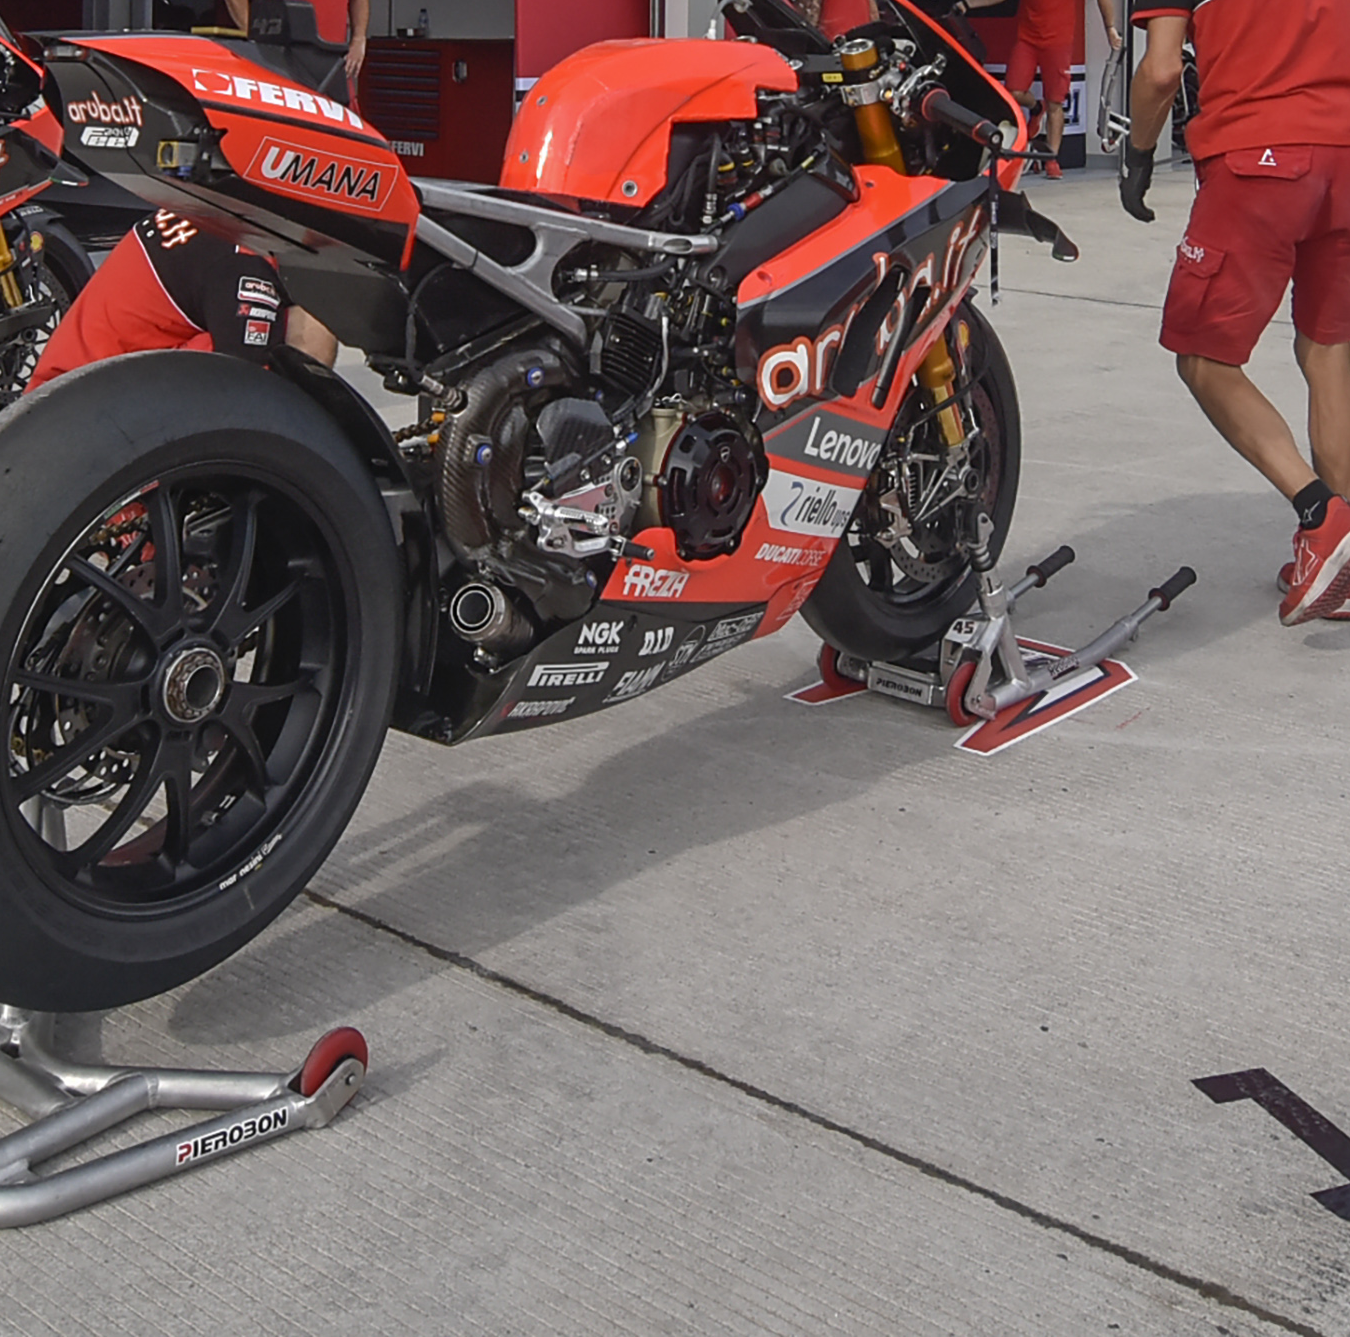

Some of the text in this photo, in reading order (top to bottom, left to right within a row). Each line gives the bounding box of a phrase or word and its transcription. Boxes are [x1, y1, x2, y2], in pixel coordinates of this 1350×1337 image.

[67, 90, 144, 128] aruba.it
[232, 76, 364, 130] FERVI
[390, 140, 426, 158] FERVI
[261, 146, 380, 202] UMANA
[804, 416, 882, 470] Lenovo
[795, 486, 838, 527] riello
[577, 620, 625, 645] NGK
[952, 620, 975, 635] 45
[526, 661, 611, 687] PIRELLI
[875, 677, 923, 697] PIEROBON
[174, 1107, 290, 1166] PIEROBON
